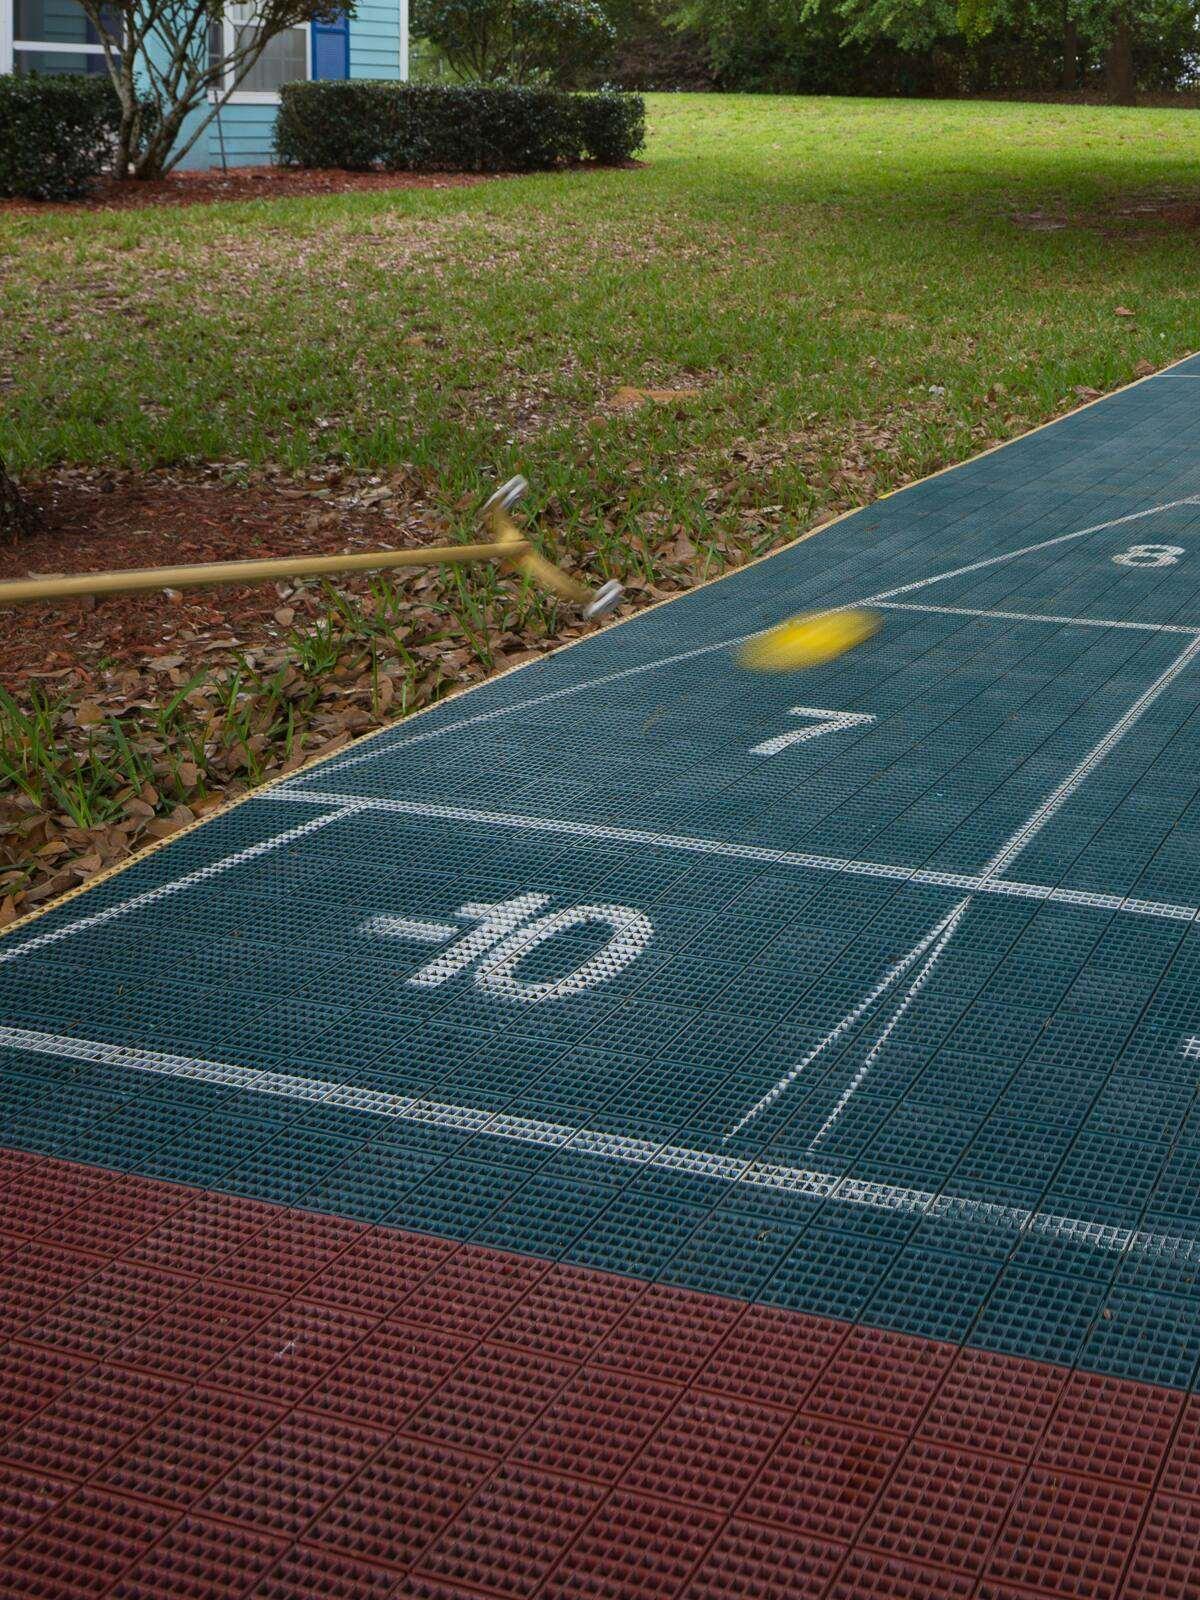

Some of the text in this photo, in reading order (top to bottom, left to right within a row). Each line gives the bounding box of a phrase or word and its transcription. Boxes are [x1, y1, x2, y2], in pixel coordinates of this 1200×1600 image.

[1111, 544, 1186, 567] 8
[748, 706, 877, 754] 7
[357, 891, 653, 1001] -10
